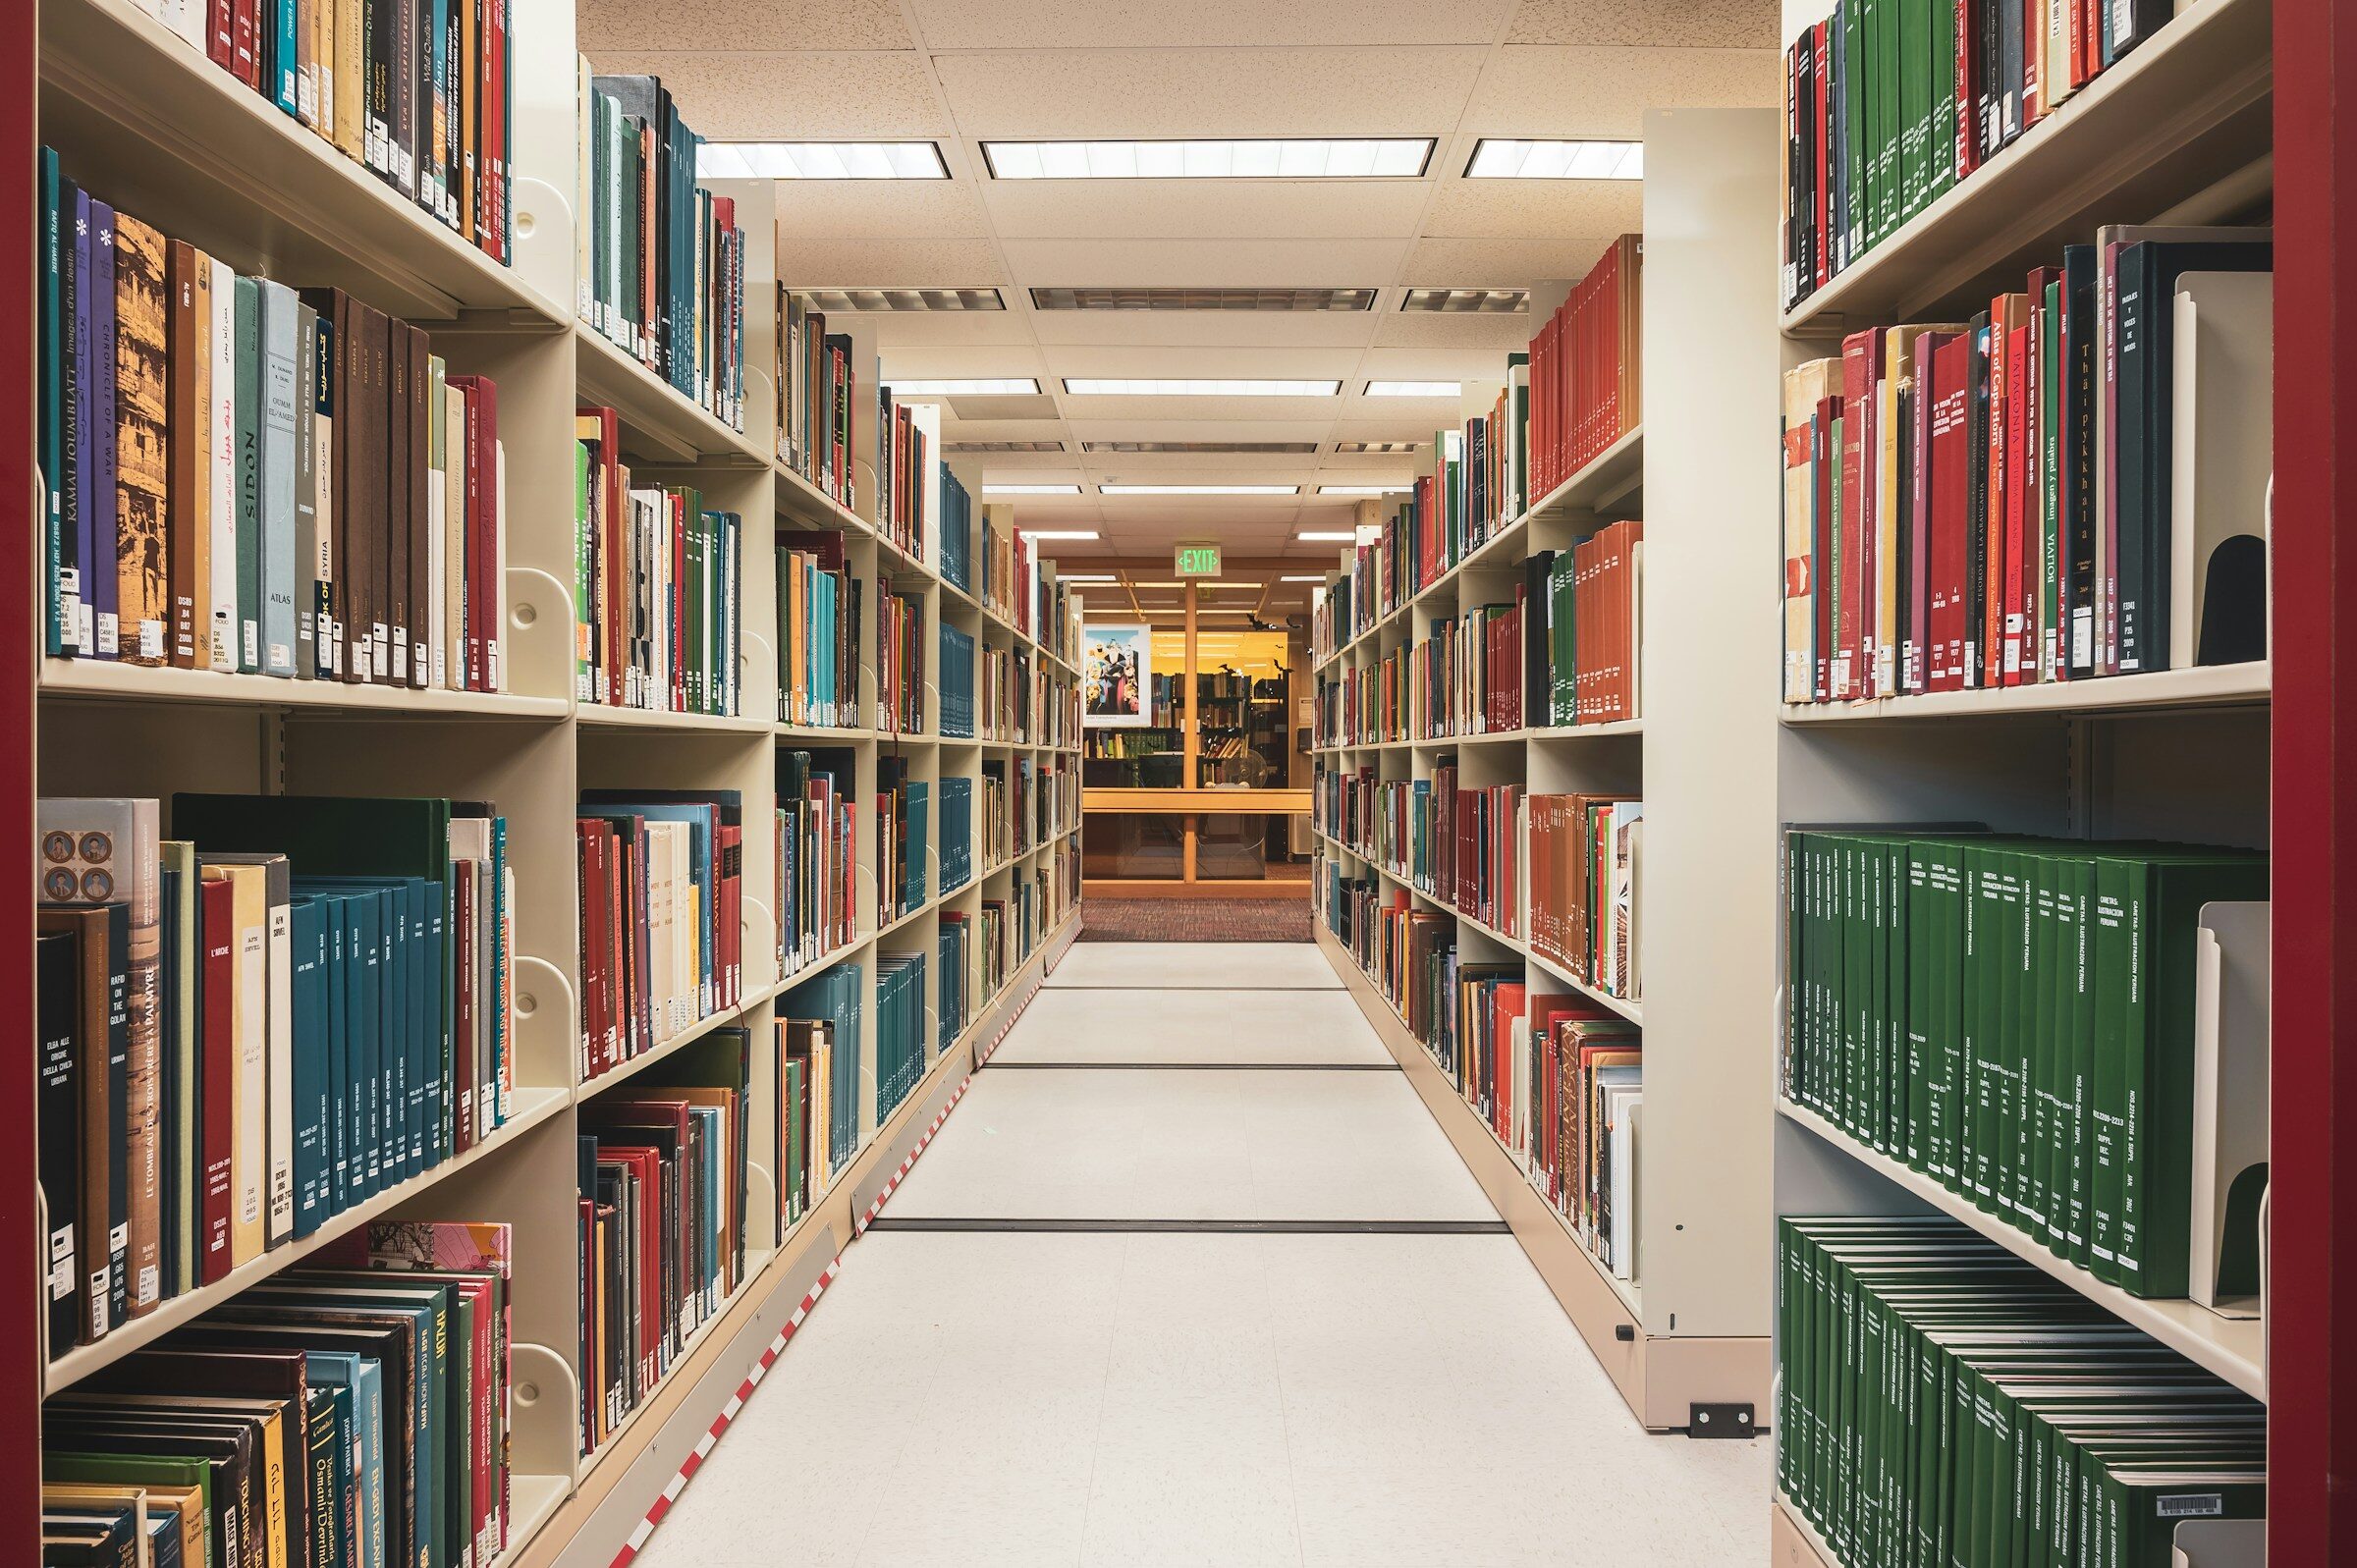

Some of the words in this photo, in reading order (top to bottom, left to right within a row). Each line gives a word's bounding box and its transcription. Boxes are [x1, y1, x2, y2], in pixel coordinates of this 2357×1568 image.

[2124, 317, 2136, 328] VOCES
[1992, 322, 2001, 354] Atlas
[2127, 331, 2132, 339] DE
[2107, 348, 2113, 356] EN
[1992, 357, 2001, 371] of
[1990, 375, 2000, 407] Cape
[2012, 352, 2021, 441] PATAGONIA
[273, 397, 291, 410] OUMM
[68, 365, 77, 462] JOUMBLATT
[104, 407, 111, 427] OF
[104, 431, 111, 439] A
[2048, 436, 2056, 472] palabra
[246, 432, 256, 518] SIDON
[68, 470, 77, 522] KAMAL
[2048, 483, 2056, 520] imagen
[1977, 536, 1984, 546] LA
[1183, 550, 1214, 573] EXIT
[1977, 549, 1984, 561] DE
[322, 581, 329, 598] OF
[270, 594, 291, 605] ATLAS
[115, 987, 122, 998] ON
[146, 965, 154, 1025] PALMYRE
[113, 1001, 122, 1011] THE
[110, 1013, 126, 1026] GOLAN
[146, 1185, 154, 1198] LE
[2096, 1210, 2109, 1221] F3401
[2098, 1222, 2106, 1231] C35
[2123, 1221, 2135, 1233] F3401
[2124, 1233, 2133, 1243] C35
[54, 1244, 66, 1255] FOLIO
[317, 1459, 327, 1510] Osmanlı
[327, 1489, 333, 1498] ve
[241, 1476, 249, 1549] TOUCHING
[345, 1485, 353, 1537] CAESAREA
[227, 1512, 235, 1545] IMAGE
